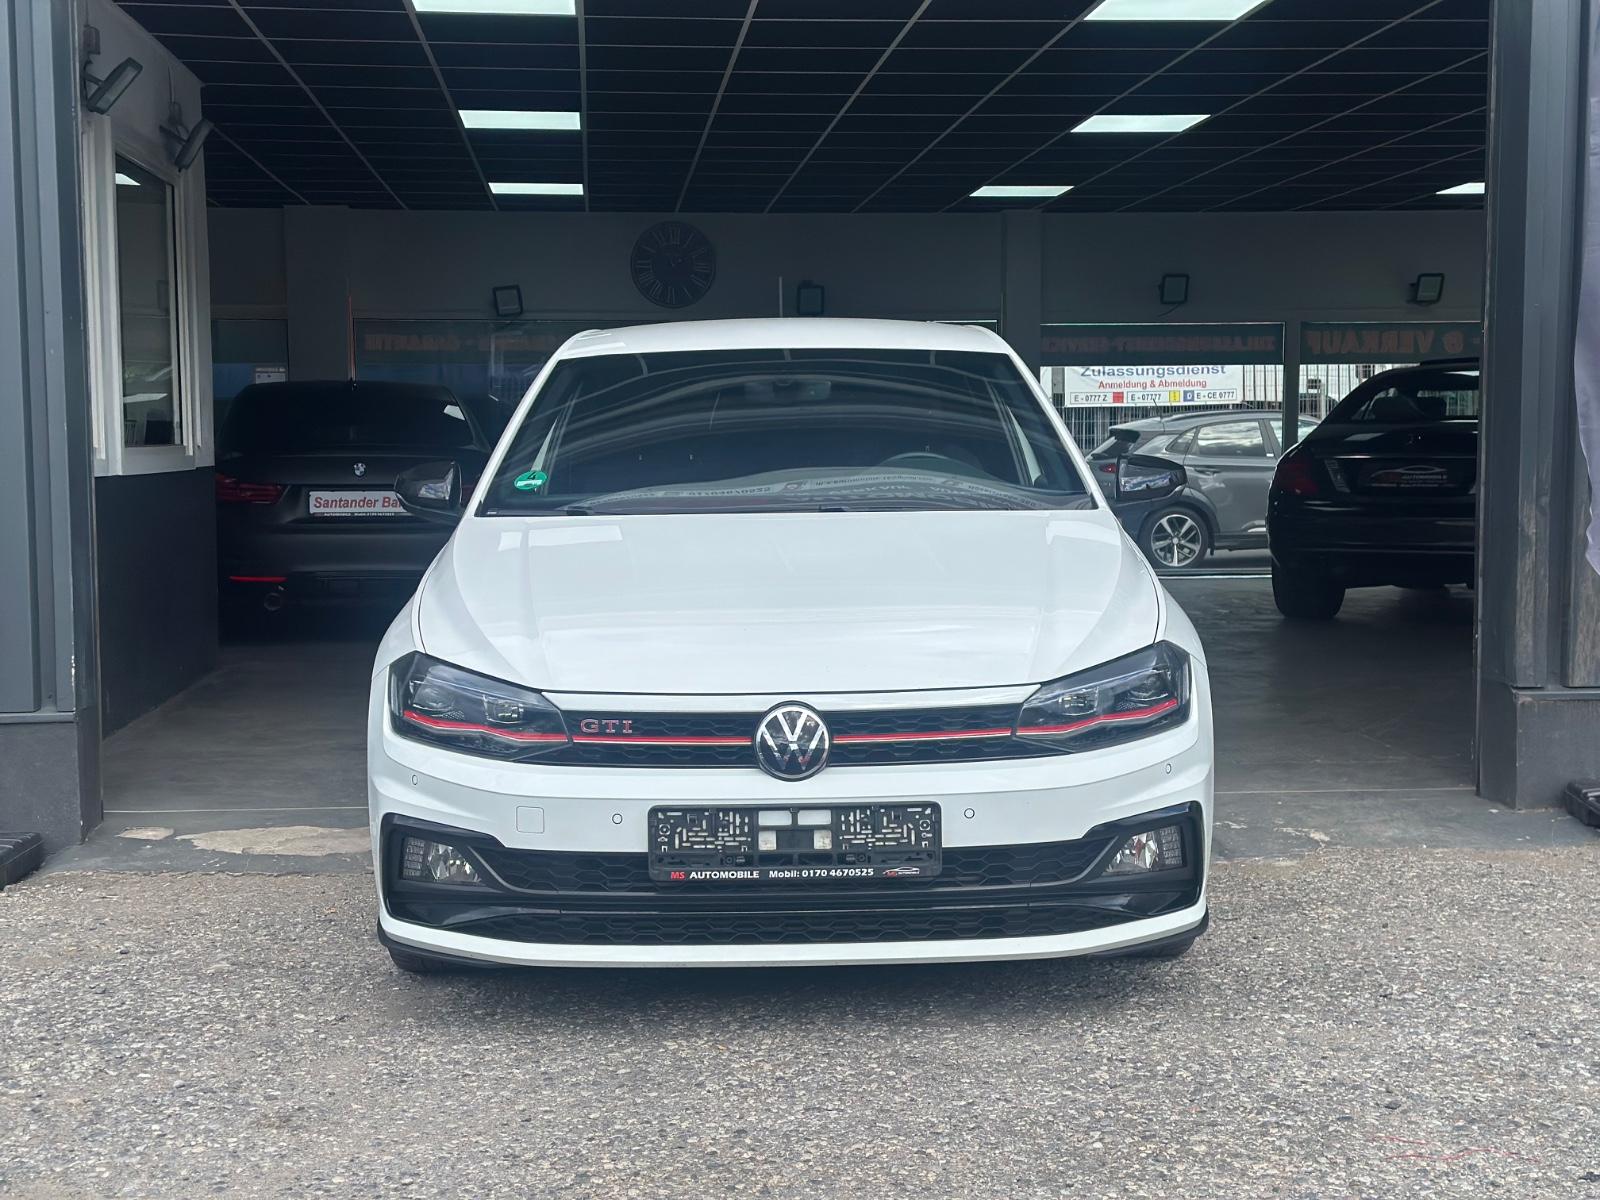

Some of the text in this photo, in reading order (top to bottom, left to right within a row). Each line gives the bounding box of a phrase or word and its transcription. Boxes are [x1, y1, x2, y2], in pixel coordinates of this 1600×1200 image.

[1080, 365, 1226, 378] Zulassungsdienst
[1098, 379, 1207, 390] Anmeldung & Abmeldung
[1074, 393, 1080, 402] E
[1085, 392, 1101, 402] 0777
[1102, 392, 1108, 402] Z
[1130, 392, 1136, 401] E
[1196, 391, 1202, 400] E
[1207, 391, 1217, 400] CE
[1218, 390, 1235, 400] 0777
[527, 471, 537, 480] 4
[313, 496, 379, 509] Santander
[580, 719, 633, 734] GTI
[670, 871, 685, 880] MS
[689, 870, 760, 880] AUTOMOBILE
[768, 869, 800, 879] Mobil:
[802, 868, 828, 878] 0170
[829, 868, 874, 878] 4670525
